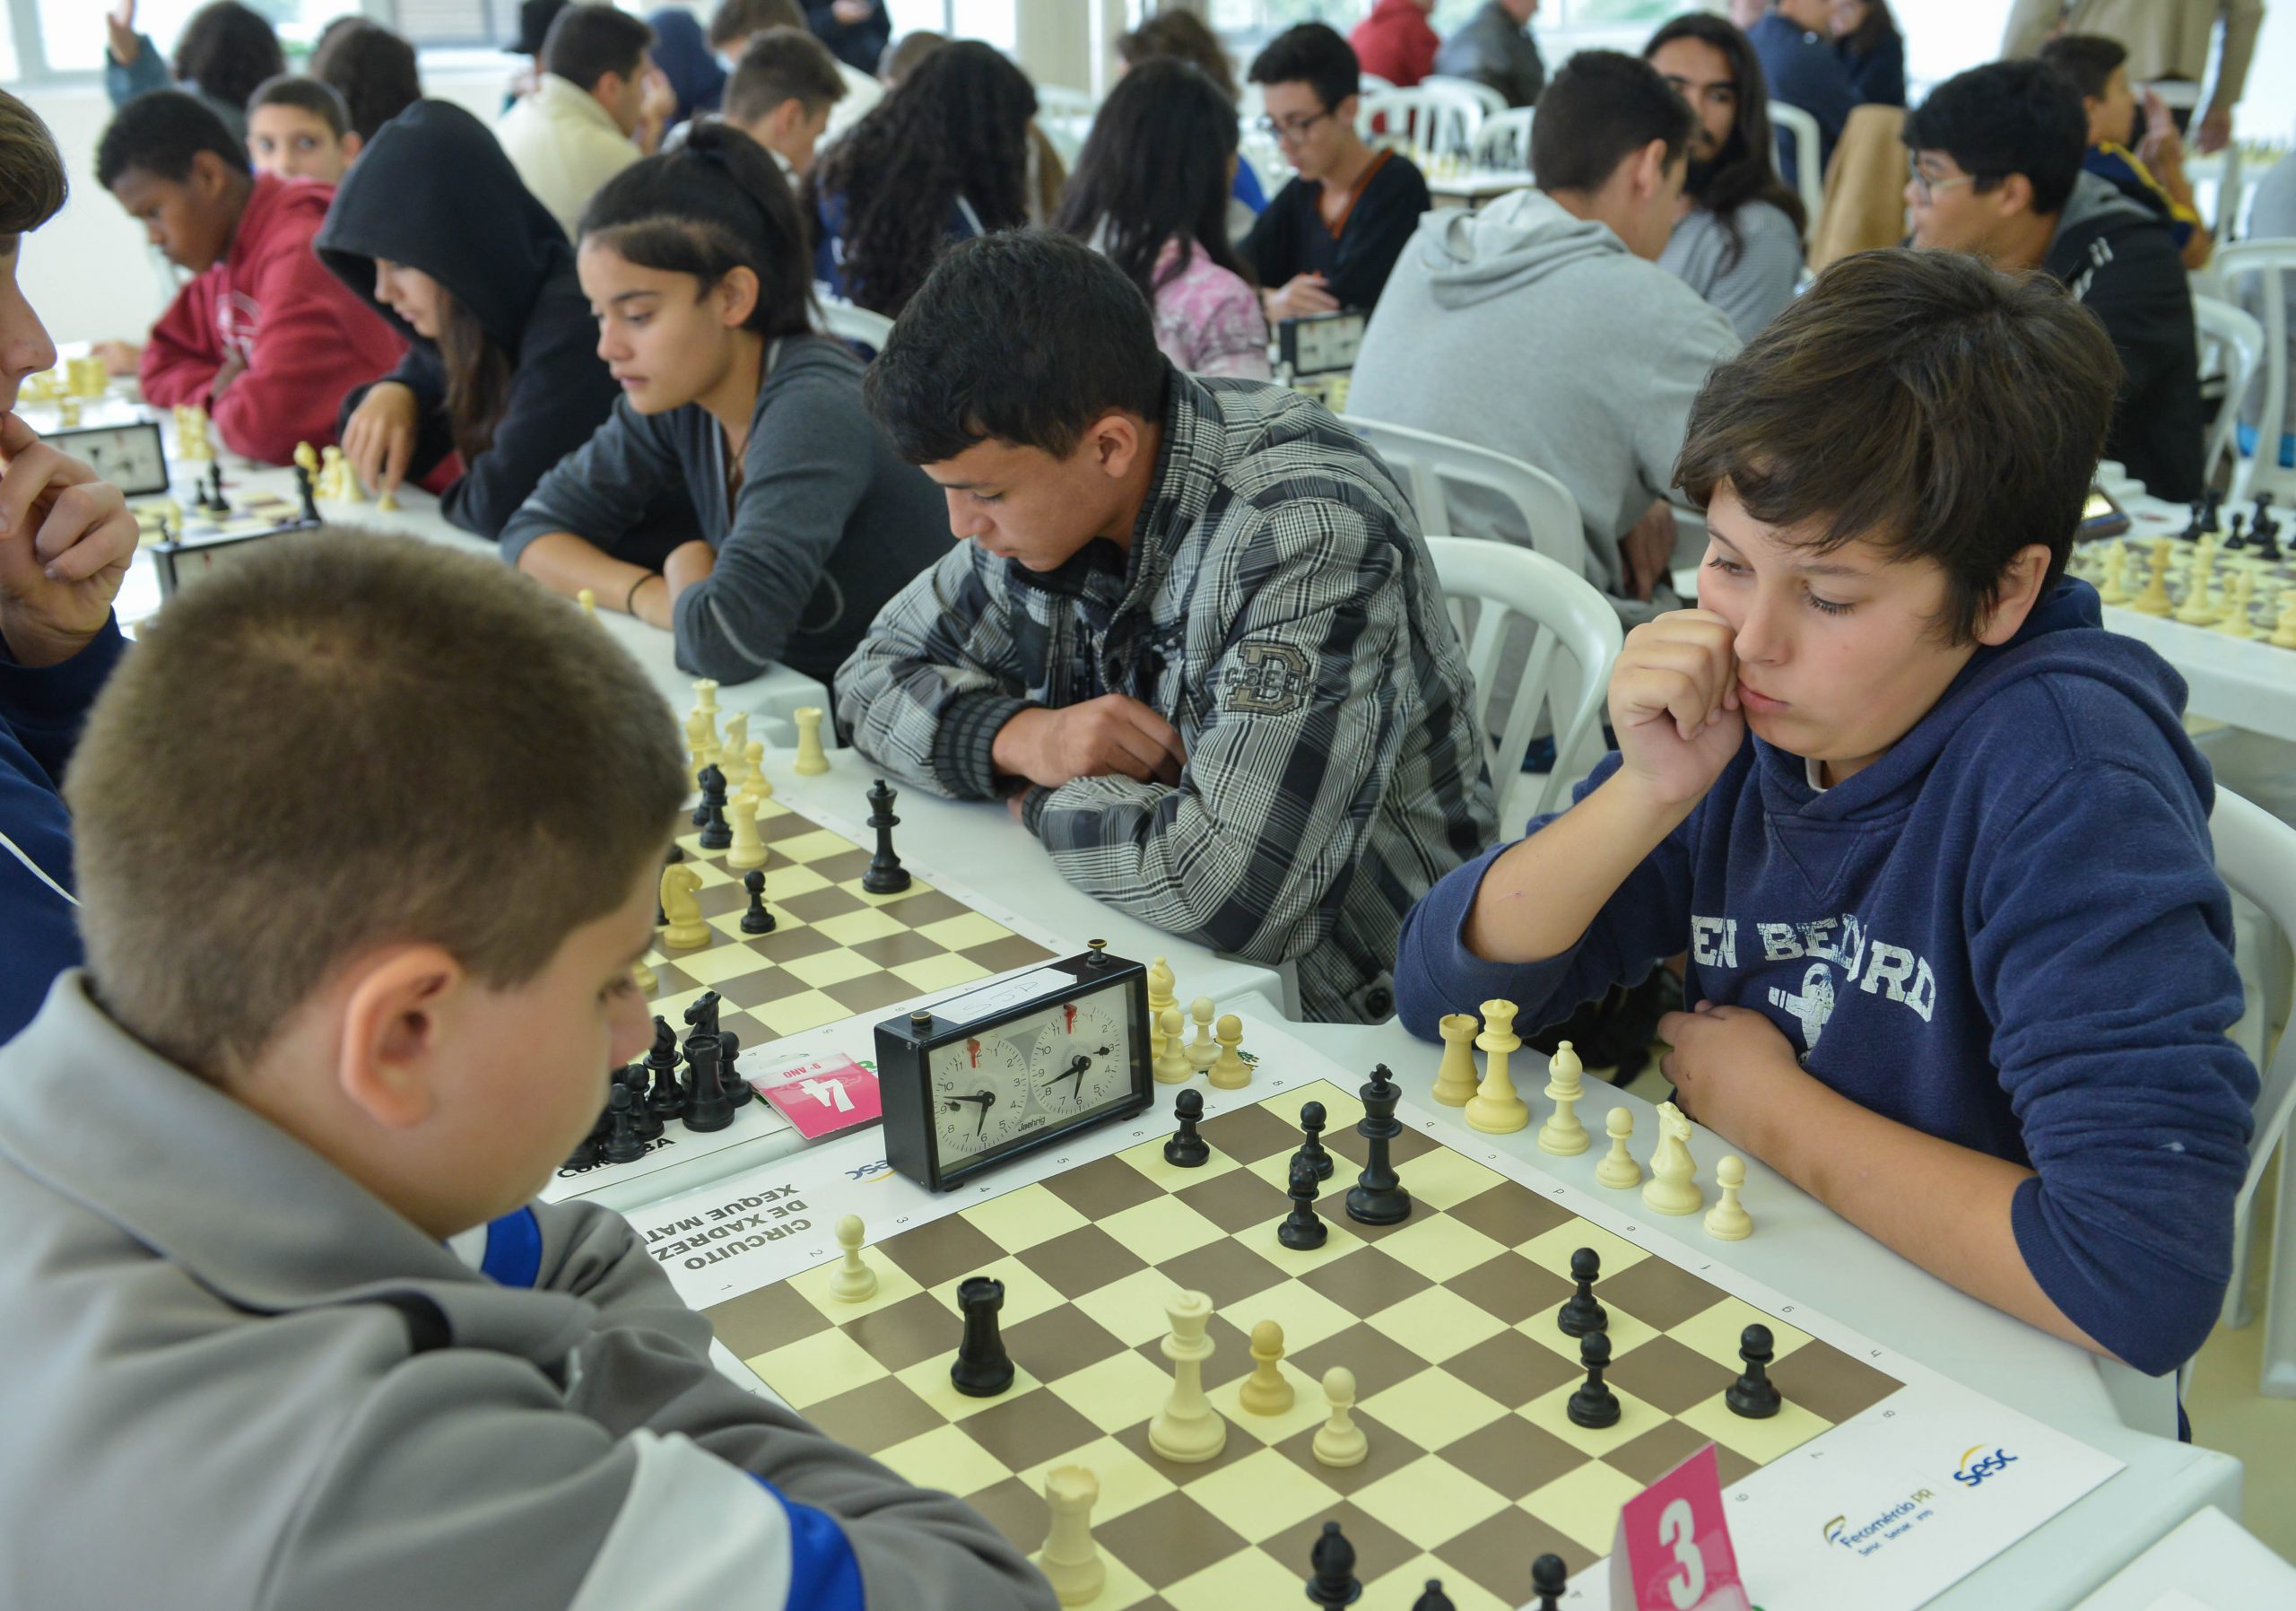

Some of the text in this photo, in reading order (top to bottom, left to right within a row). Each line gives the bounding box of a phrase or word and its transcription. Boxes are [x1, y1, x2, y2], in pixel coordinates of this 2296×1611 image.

[783, 1067, 807, 1078] ANO
[798, 1078, 855, 1112] 4
[845, 1160, 890, 1180] esc
[646, 1184, 800, 1244] XEQUE MAT
[650, 1200, 808, 1261] DE XADREZ
[684, 1219, 812, 1270] CIRCUITO
[810, 1249, 823, 1258] 2
[1953, 1449, 2018, 1487] Sesc
[1839, 1502, 1916, 1548] Fecomércio
[1910, 1489, 1935, 1504] PR
[1658, 1497, 1706, 1610] 3
